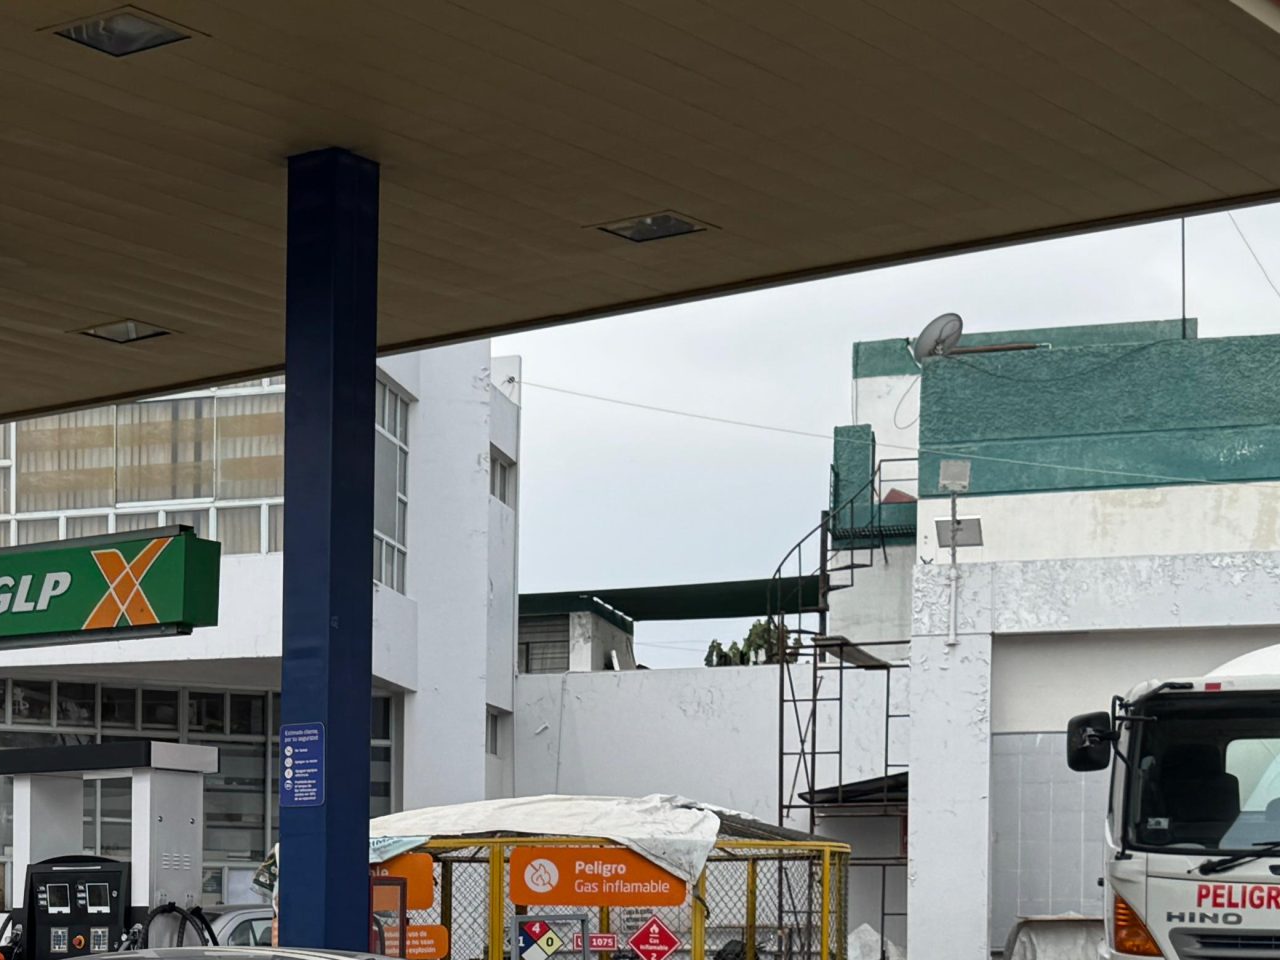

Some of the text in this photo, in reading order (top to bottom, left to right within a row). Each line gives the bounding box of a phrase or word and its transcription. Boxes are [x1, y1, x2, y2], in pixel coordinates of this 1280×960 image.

[575, 861, 626, 877] Peligro
[575, 880, 670, 893] Gas inflamable
[1166, 911, 1243, 925] HINO
[532, 926, 541, 934] 4
[518, 937, 525, 947] 1
[546, 937, 554, 947] 0
[592, 938, 613, 947] 1075
[649, 937, 660, 945] Gas
